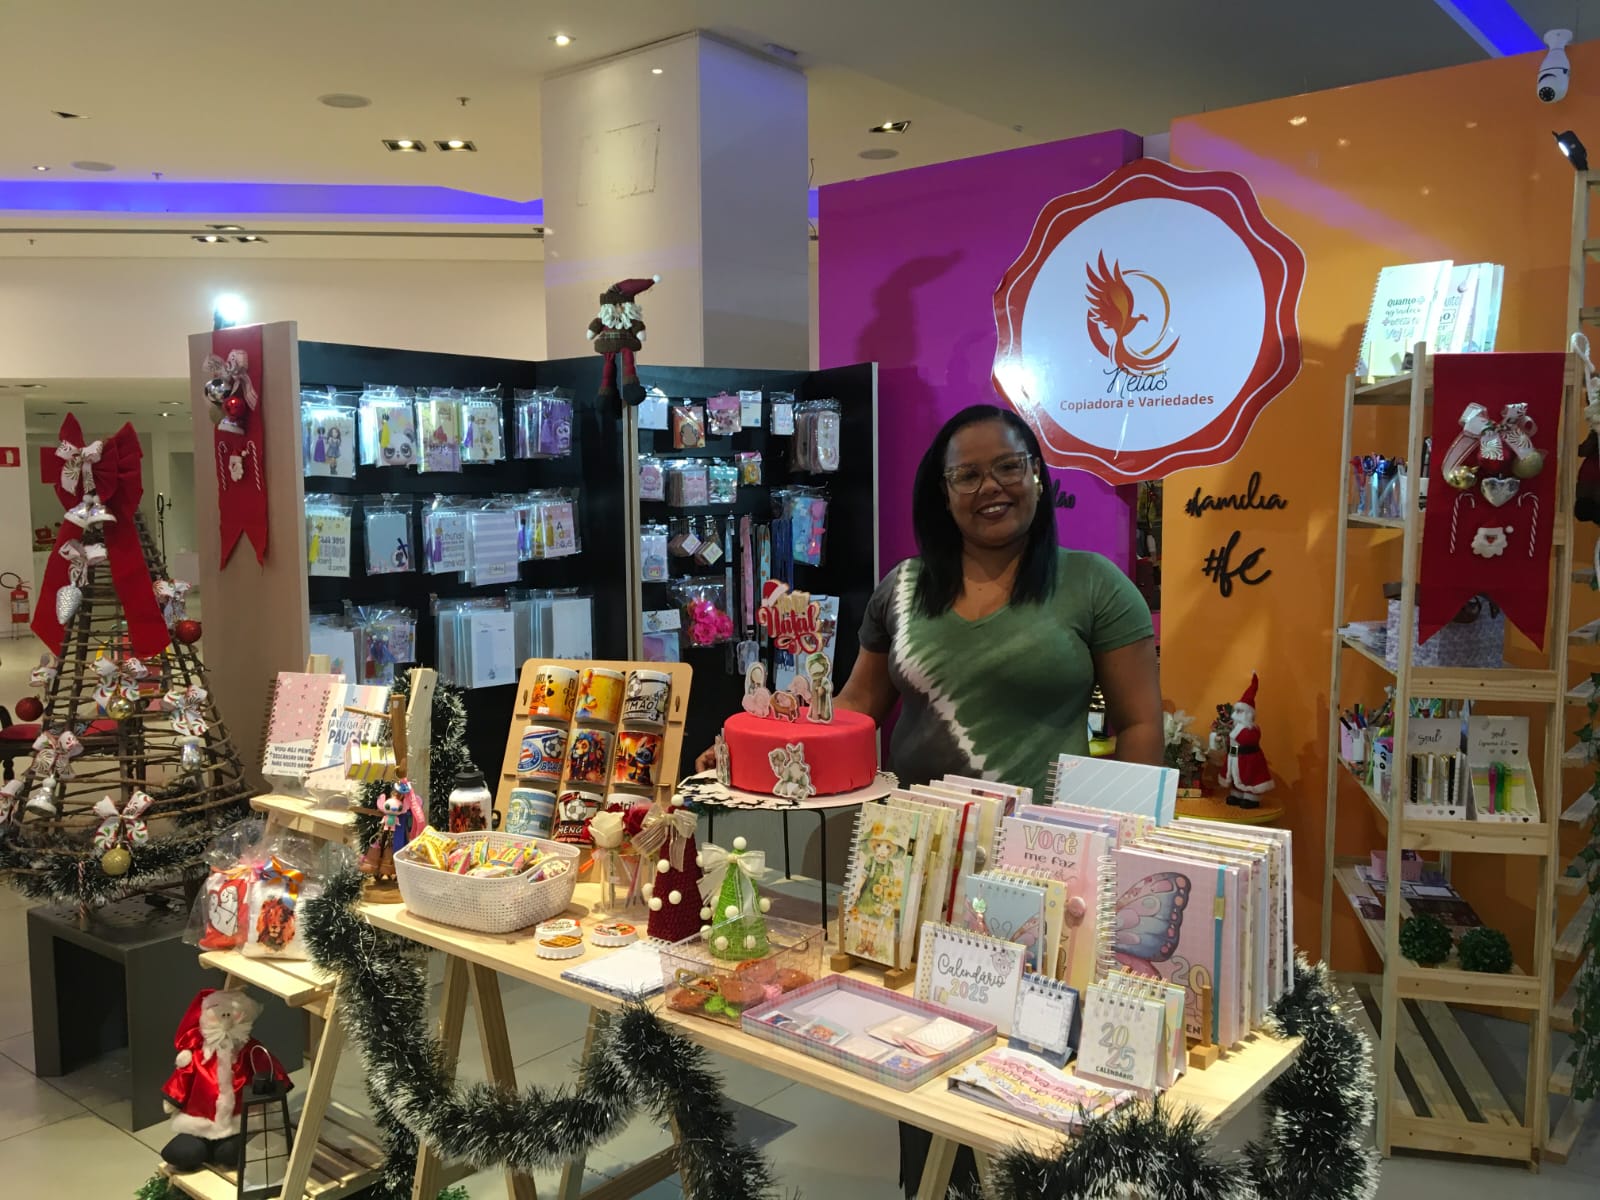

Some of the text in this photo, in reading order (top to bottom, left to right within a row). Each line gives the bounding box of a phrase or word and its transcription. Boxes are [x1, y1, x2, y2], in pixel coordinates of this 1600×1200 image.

[1059, 394, 1215, 413] Copiadora e Variedades
[756, 604, 817, 639] Natal
[1023, 825, 1078, 855] Você
[1024, 852, 1076, 868] me faz
[937, 953, 1006, 988] Calendário
[1171, 955, 1212, 996] 20
[950, 978, 990, 1004] 2025
[1098, 1022, 1129, 1048] 20
[1105, 1046, 1137, 1072] 25
